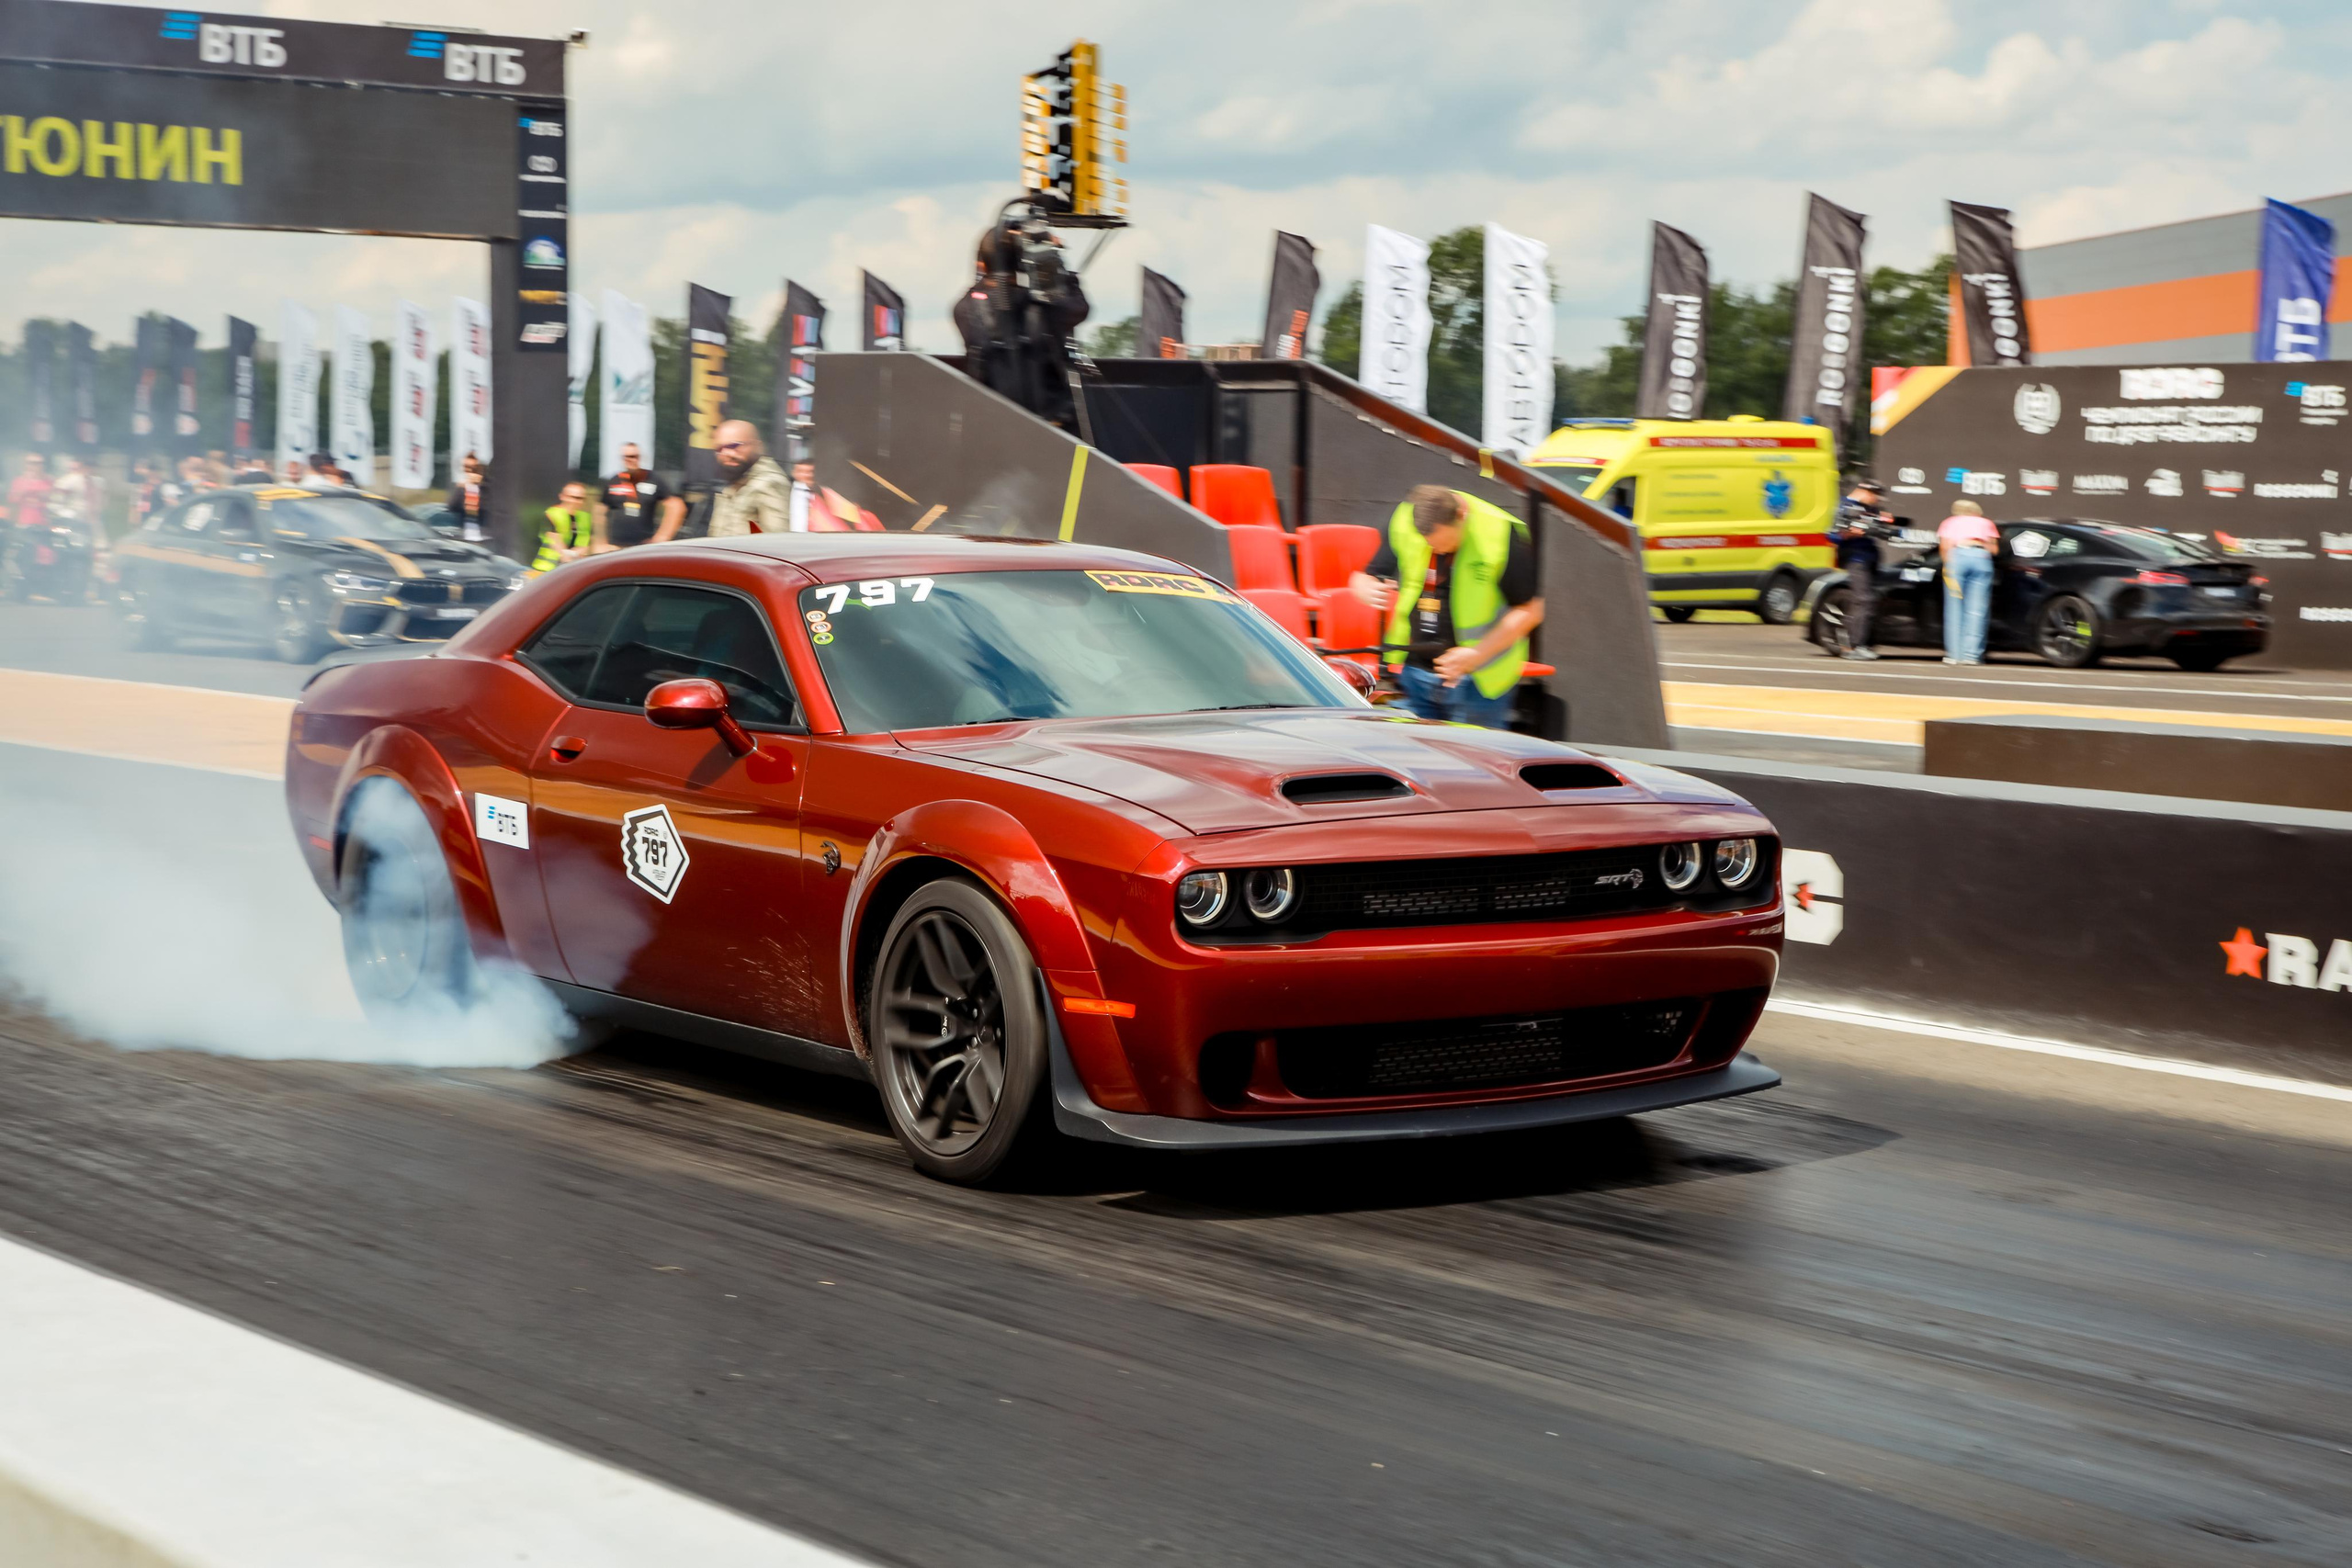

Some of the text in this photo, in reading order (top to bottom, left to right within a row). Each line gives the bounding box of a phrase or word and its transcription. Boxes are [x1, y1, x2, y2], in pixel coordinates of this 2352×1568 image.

[198, 23, 287, 68] ВТБ
[444, 43, 526, 85] ВТБ
[0, 114, 243, 186] ЮНИН
[815, 577, 935, 615] 797
[641, 836, 668, 868] 797
[1594, 874, 1634, 886] SRT
